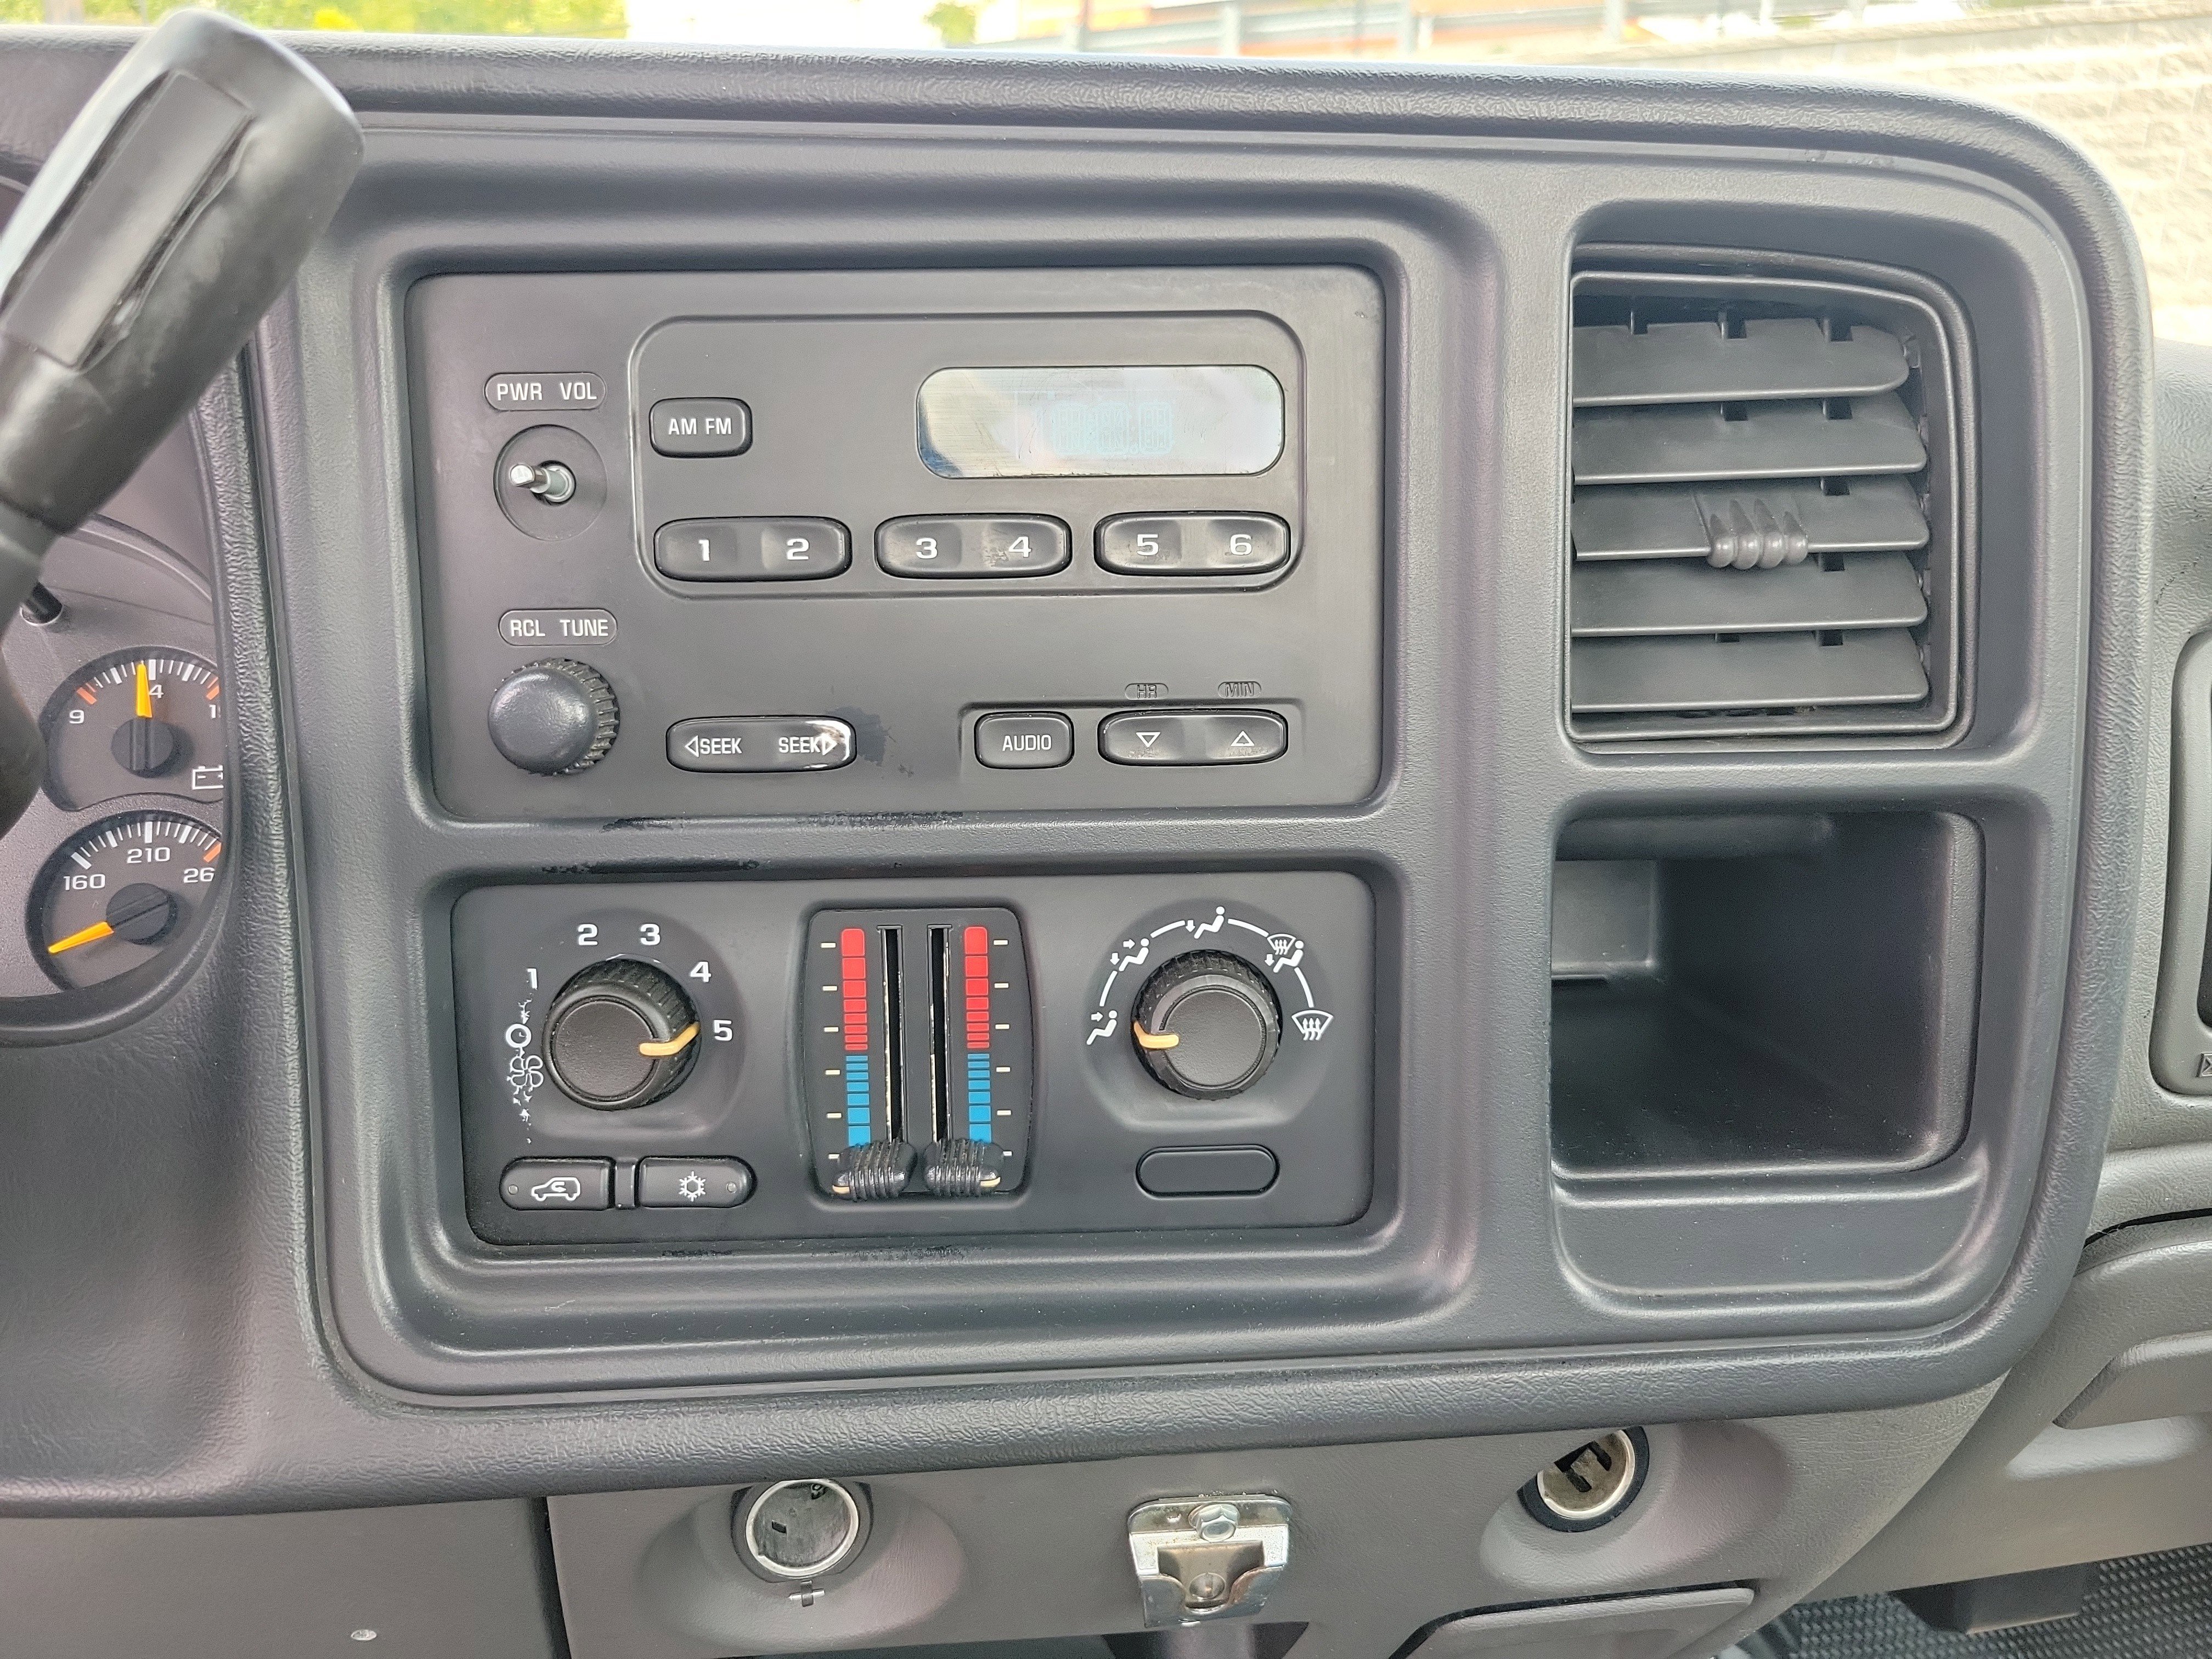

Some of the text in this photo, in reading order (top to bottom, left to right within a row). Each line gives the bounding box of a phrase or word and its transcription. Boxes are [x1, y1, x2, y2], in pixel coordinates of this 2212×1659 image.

[496, 382, 597, 401] PWR VOL
[668, 417, 732, 435] AM FM
[698, 539, 710, 562] 1
[786, 538, 810, 561] 2
[915, 537, 939, 560] 3
[1008, 535, 1032, 558] 4
[1136, 533, 1159, 557] 5
[1229, 533, 1252, 556] 6
[510, 619, 609, 637] RCL TUNE
[149, 684, 164, 699] 4
[1136, 684, 1158, 699] HR
[1224, 682, 1255, 698] MIN
[69, 709, 84, 724] 9
[209, 704, 221, 719] 1
[700, 738, 742, 755] SEEK
[778, 736, 821, 754] SEEK
[1002, 735, 1052, 751] AUDIO
[127, 847, 171, 864] 210
[63, 873, 106, 890] 160
[183, 867, 215, 883] 26
[578, 923, 599, 946] 2
[640, 923, 661, 946] 3
[527, 968, 538, 990] 1
[690, 962, 712, 982] 4
[714, 1020, 732, 1041] 5
